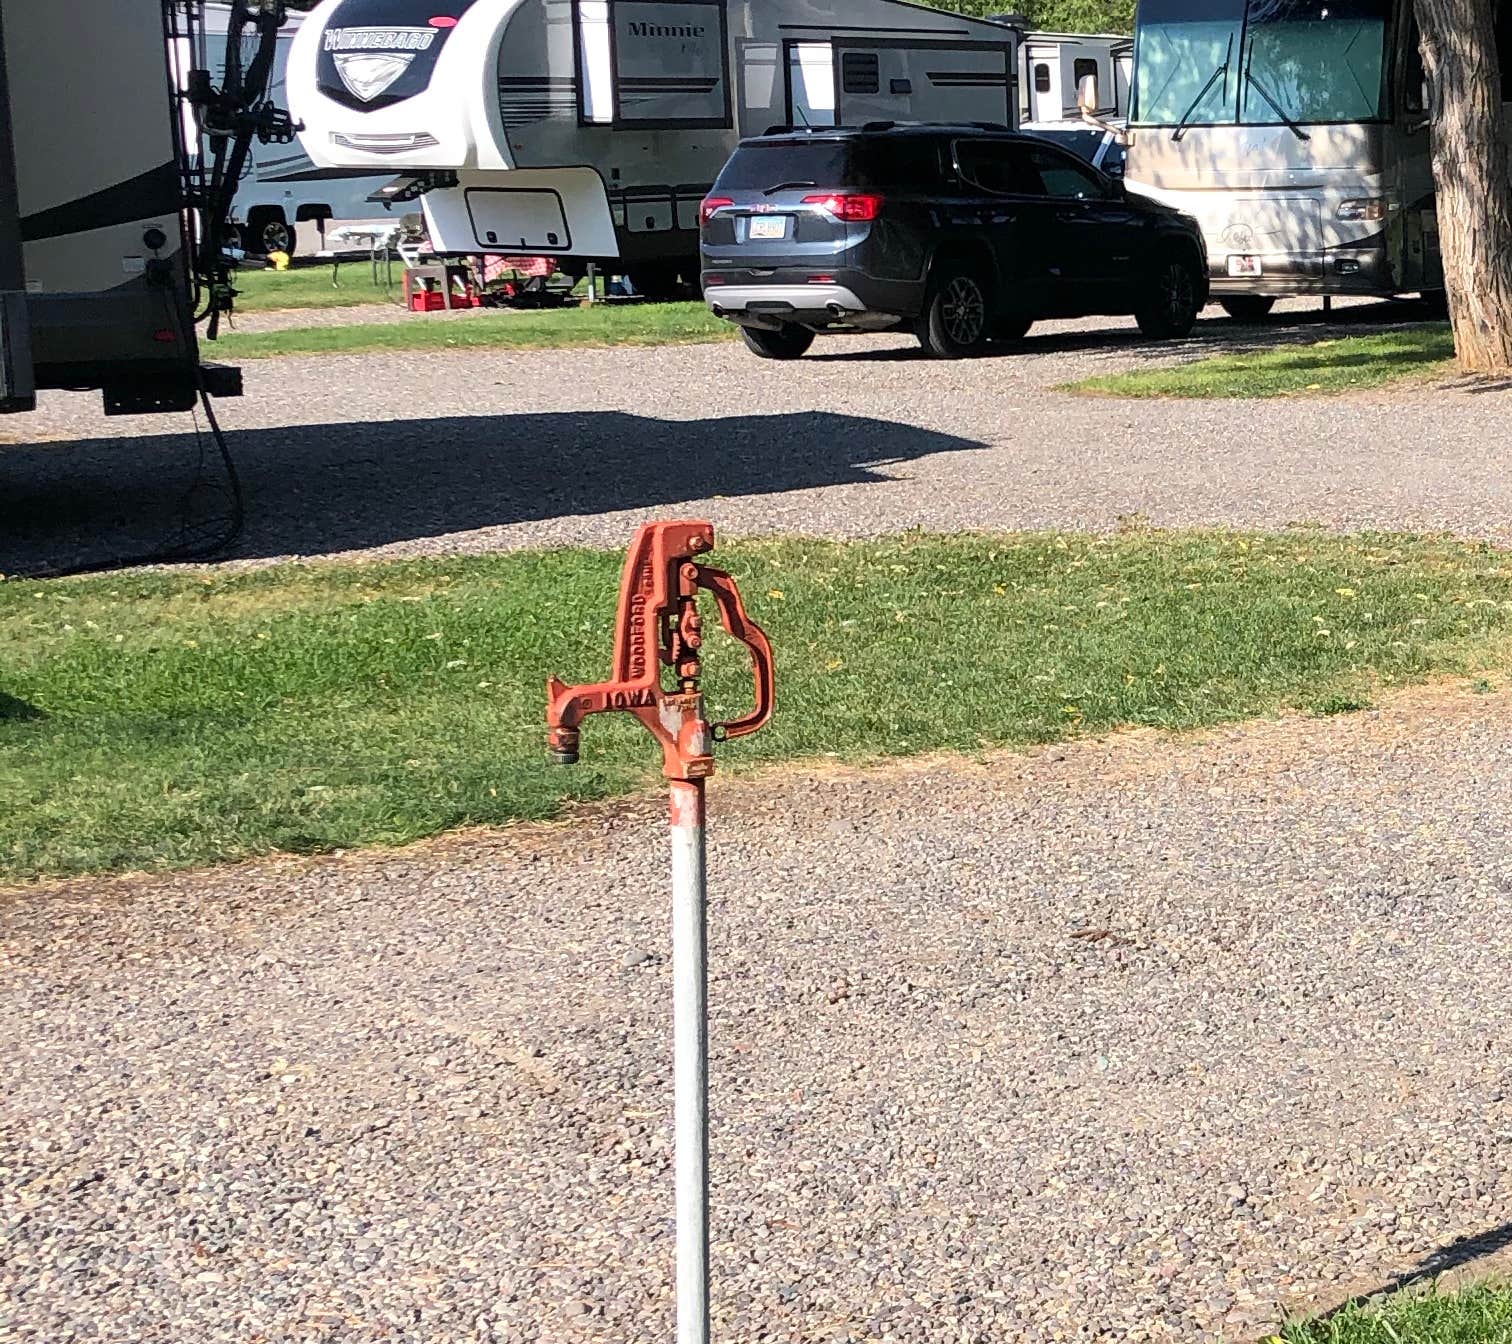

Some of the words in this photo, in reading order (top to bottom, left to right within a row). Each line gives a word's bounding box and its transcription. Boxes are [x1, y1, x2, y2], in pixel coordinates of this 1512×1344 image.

[324, 28, 435, 51] WINNEBAGO
[628, 21, 705, 38] Minnie
[631, 593, 647, 679] WOODFORD
[604, 690, 657, 709] IOWA
